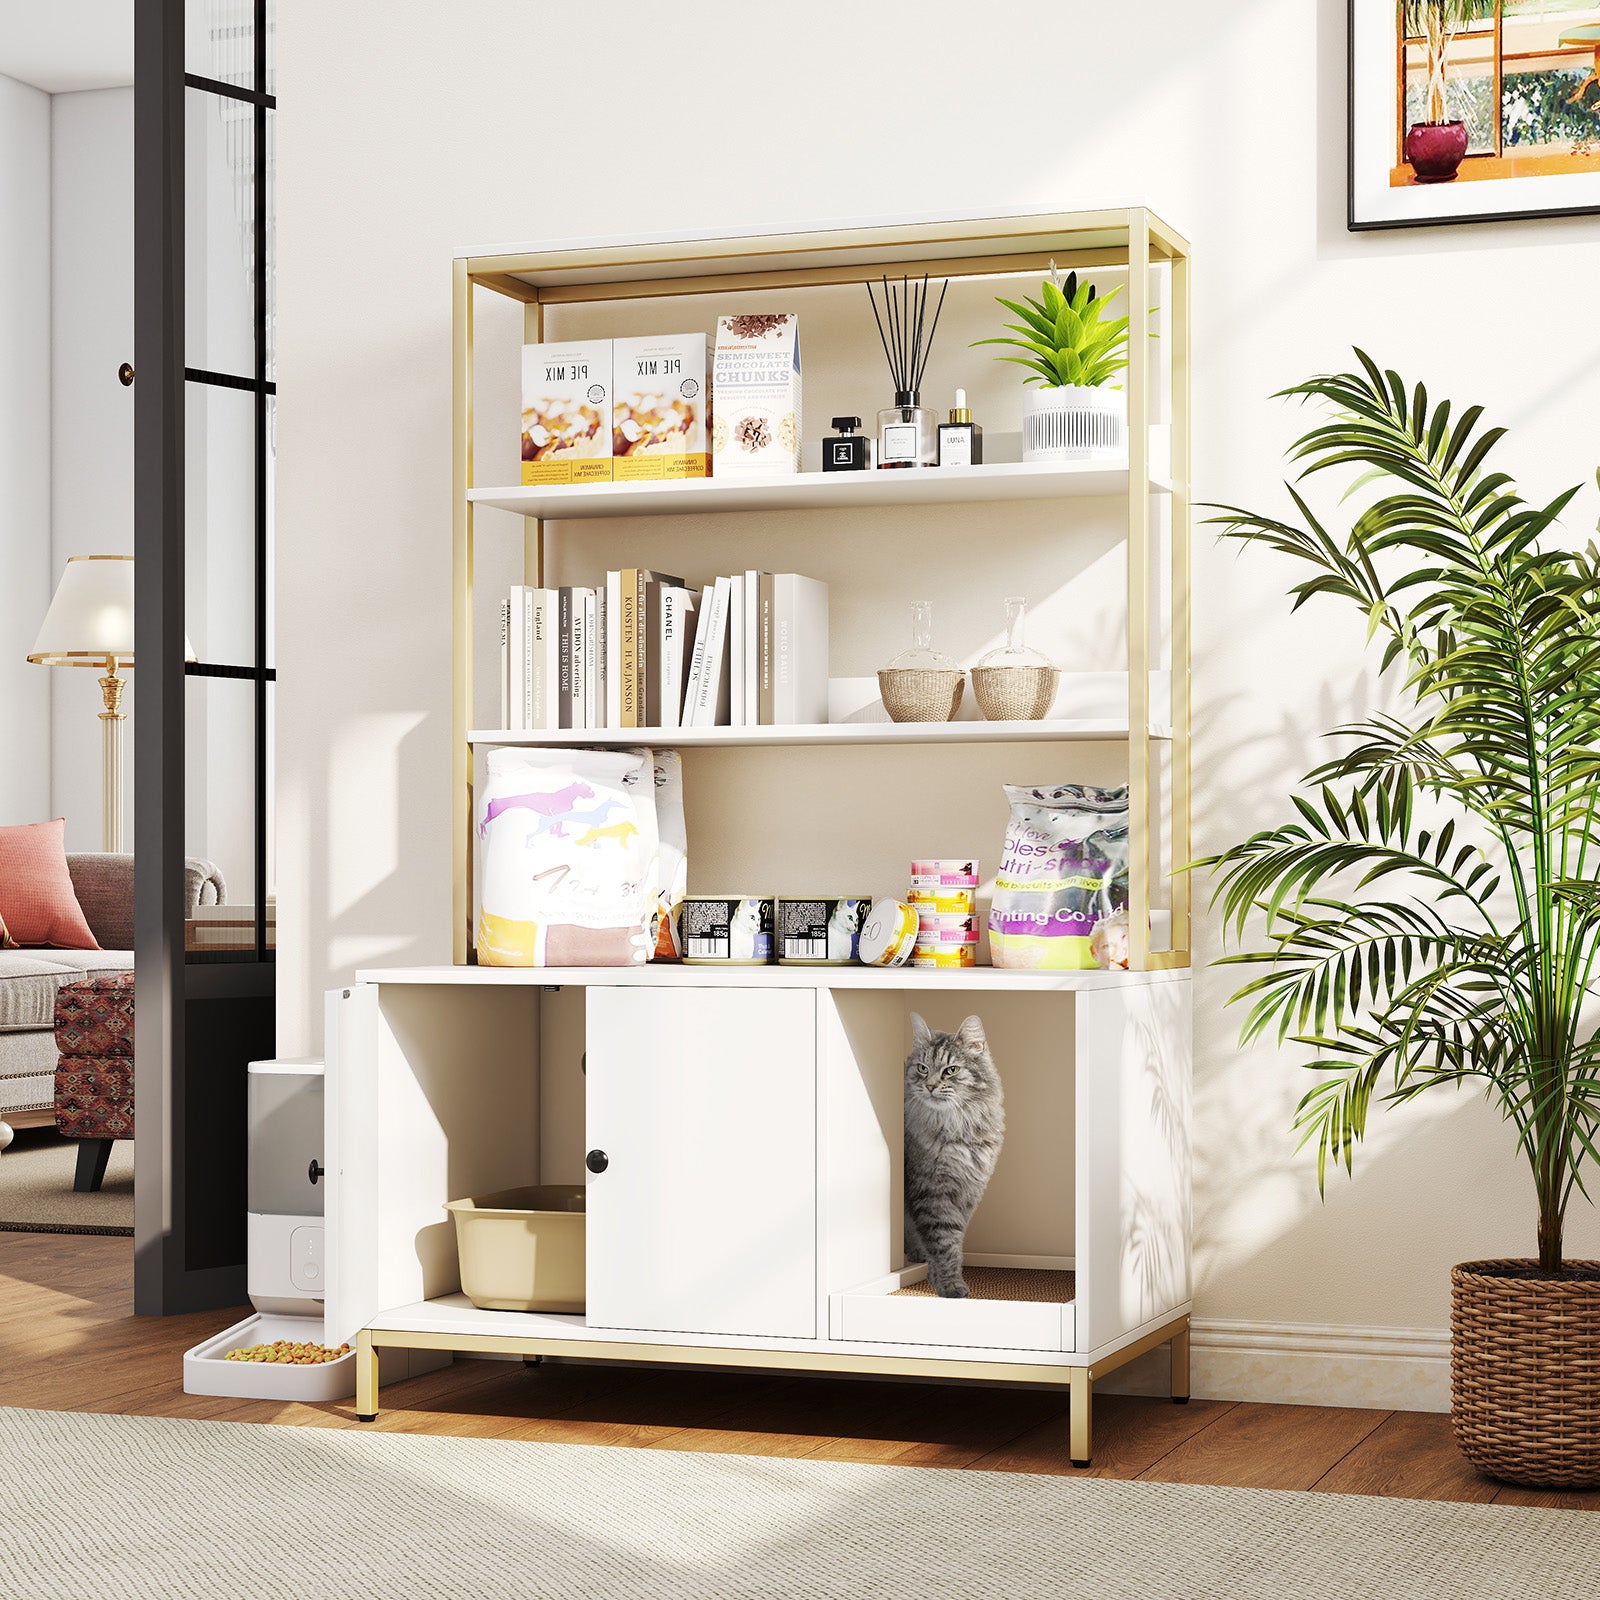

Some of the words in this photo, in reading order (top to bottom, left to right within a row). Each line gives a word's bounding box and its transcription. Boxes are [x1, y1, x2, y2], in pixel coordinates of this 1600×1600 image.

[716, 352, 790, 360] SEMISWEET
[716, 361, 790, 369] CHOCOLATE
[716, 370, 790, 383] CHUNKS
[946, 436, 964, 444] LUNA
[624, 650, 632, 712] H.W.JANSON
[1022, 826, 1051, 841] love
